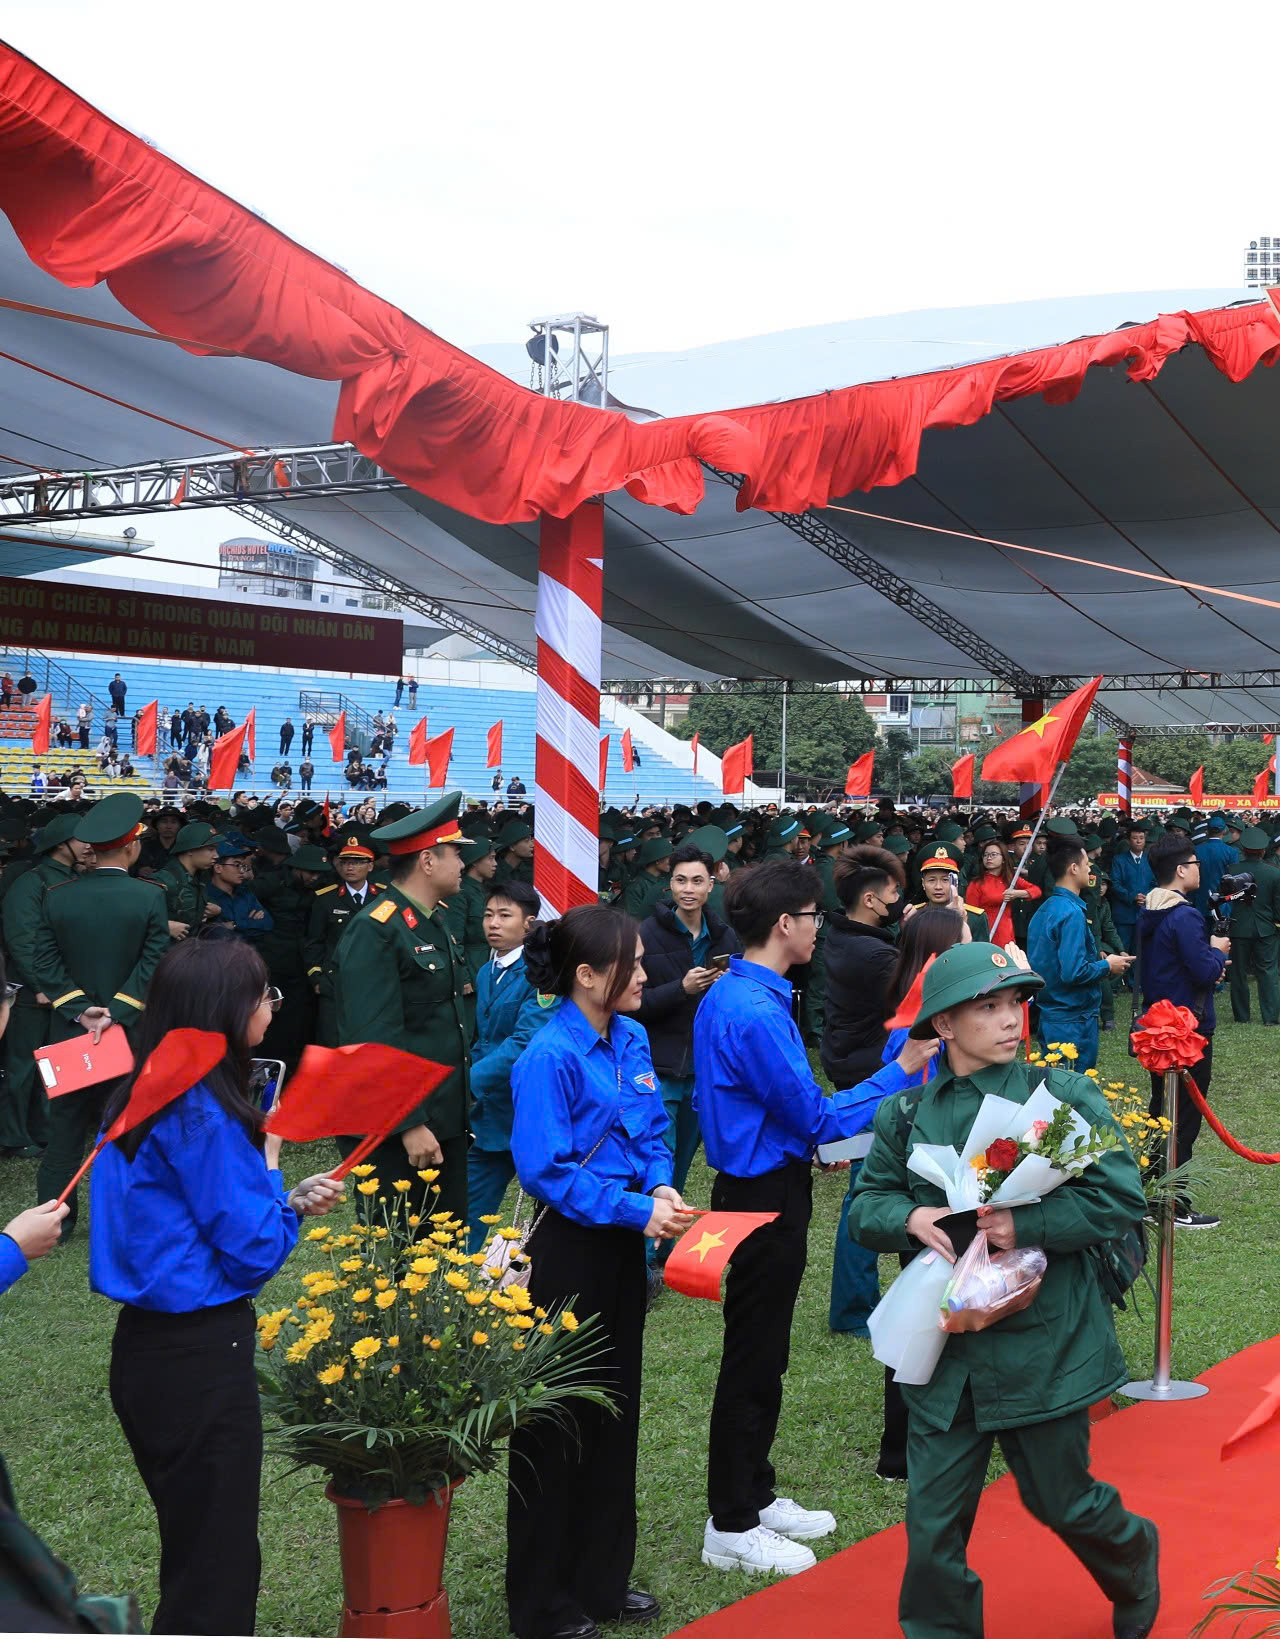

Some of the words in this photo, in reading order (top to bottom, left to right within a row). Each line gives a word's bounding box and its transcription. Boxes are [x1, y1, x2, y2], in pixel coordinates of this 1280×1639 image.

[247, 545, 268, 555] HOTEL
[0, 585, 45, 609] GƯỜI
[142, 602, 202, 625] TRONG
[208, 607, 255, 630] QUÂN
[260, 612, 288, 636] ĐỘI
[293, 617, 338, 639] NHÂN
[343, 621, 376, 641] DÂN
[30, 620, 59, 640] AN
[65, 623, 122, 645] NHÂN
[127, 627, 166, 649] DÂN
[171, 631, 209, 656] VIỆT
[215, 637, 255, 657] NAM
[1202, 798, 1226, 807] HƠN
[1236, 799, 1253, 807] XA
